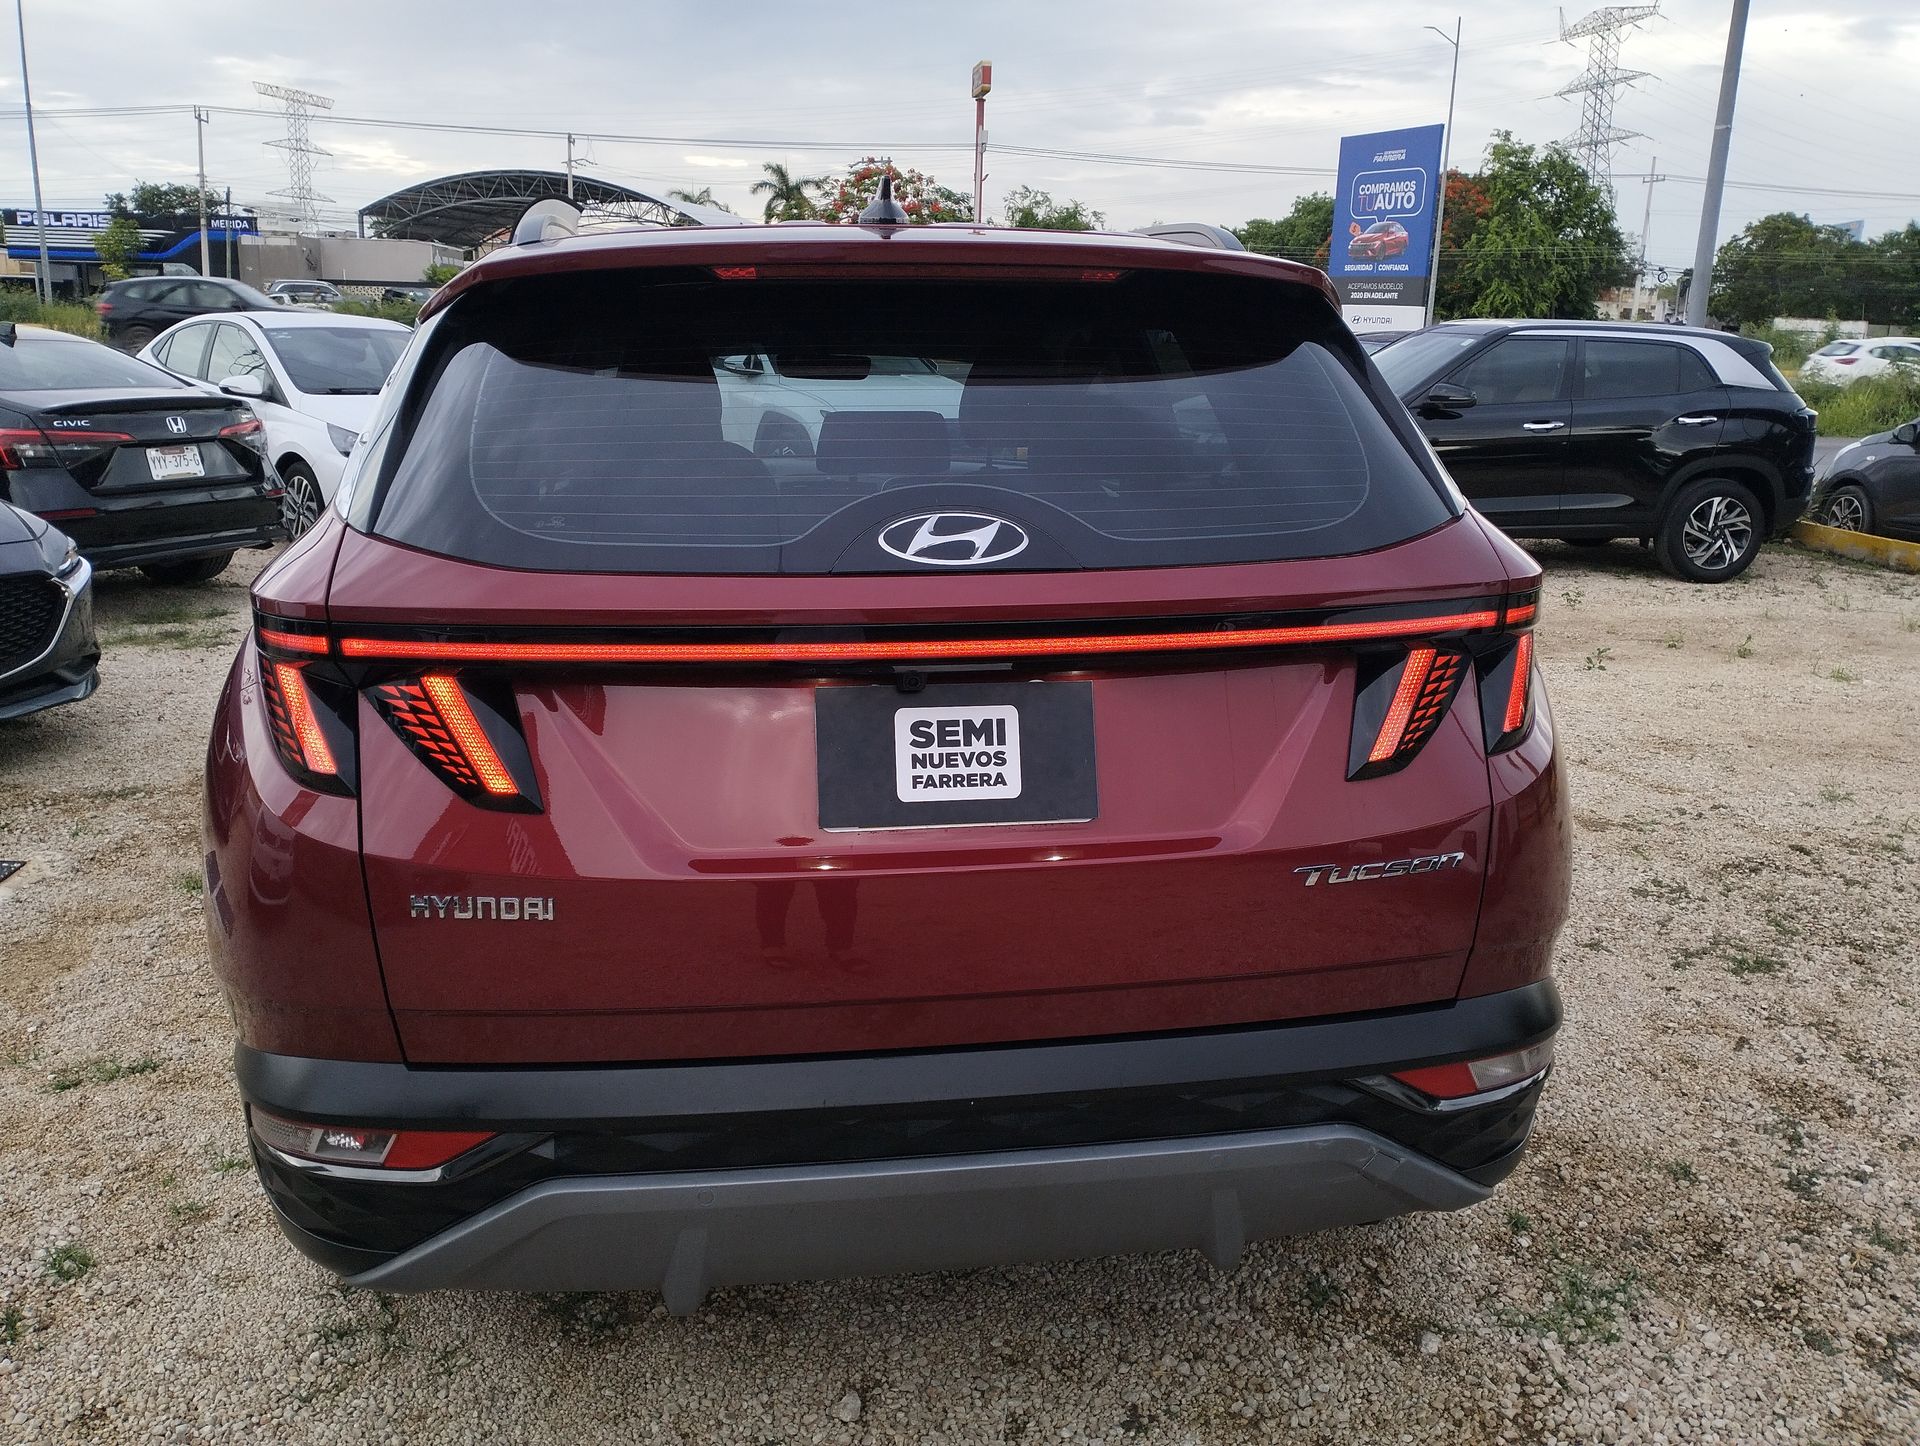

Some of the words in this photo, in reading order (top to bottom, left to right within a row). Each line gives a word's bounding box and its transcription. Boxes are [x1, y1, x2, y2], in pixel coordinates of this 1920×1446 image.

[1359, 180, 1416, 195] COMPRAMOS
[1358, 194, 1376, 212] TU
[1374, 191, 1415, 211] AUTO
[16, 211, 112, 228] POLARIS
[1378, 264, 1409, 272] CONFIANZA
[1347, 282, 1377, 290] ACEPTAMOS
[1377, 282, 1404, 290] MODELOS
[1371, 292, 1398, 300] ADELANTE
[1363, 316, 1393, 325] HYUNDAI
[53, 419, 91, 427] CIVIC
[909, 718, 1007, 749] SEMI
[911, 750, 1007, 770] NUEVOS
[911, 772, 1008, 790] FARRERA
[409, 895, 554, 921] HYUNDAI
